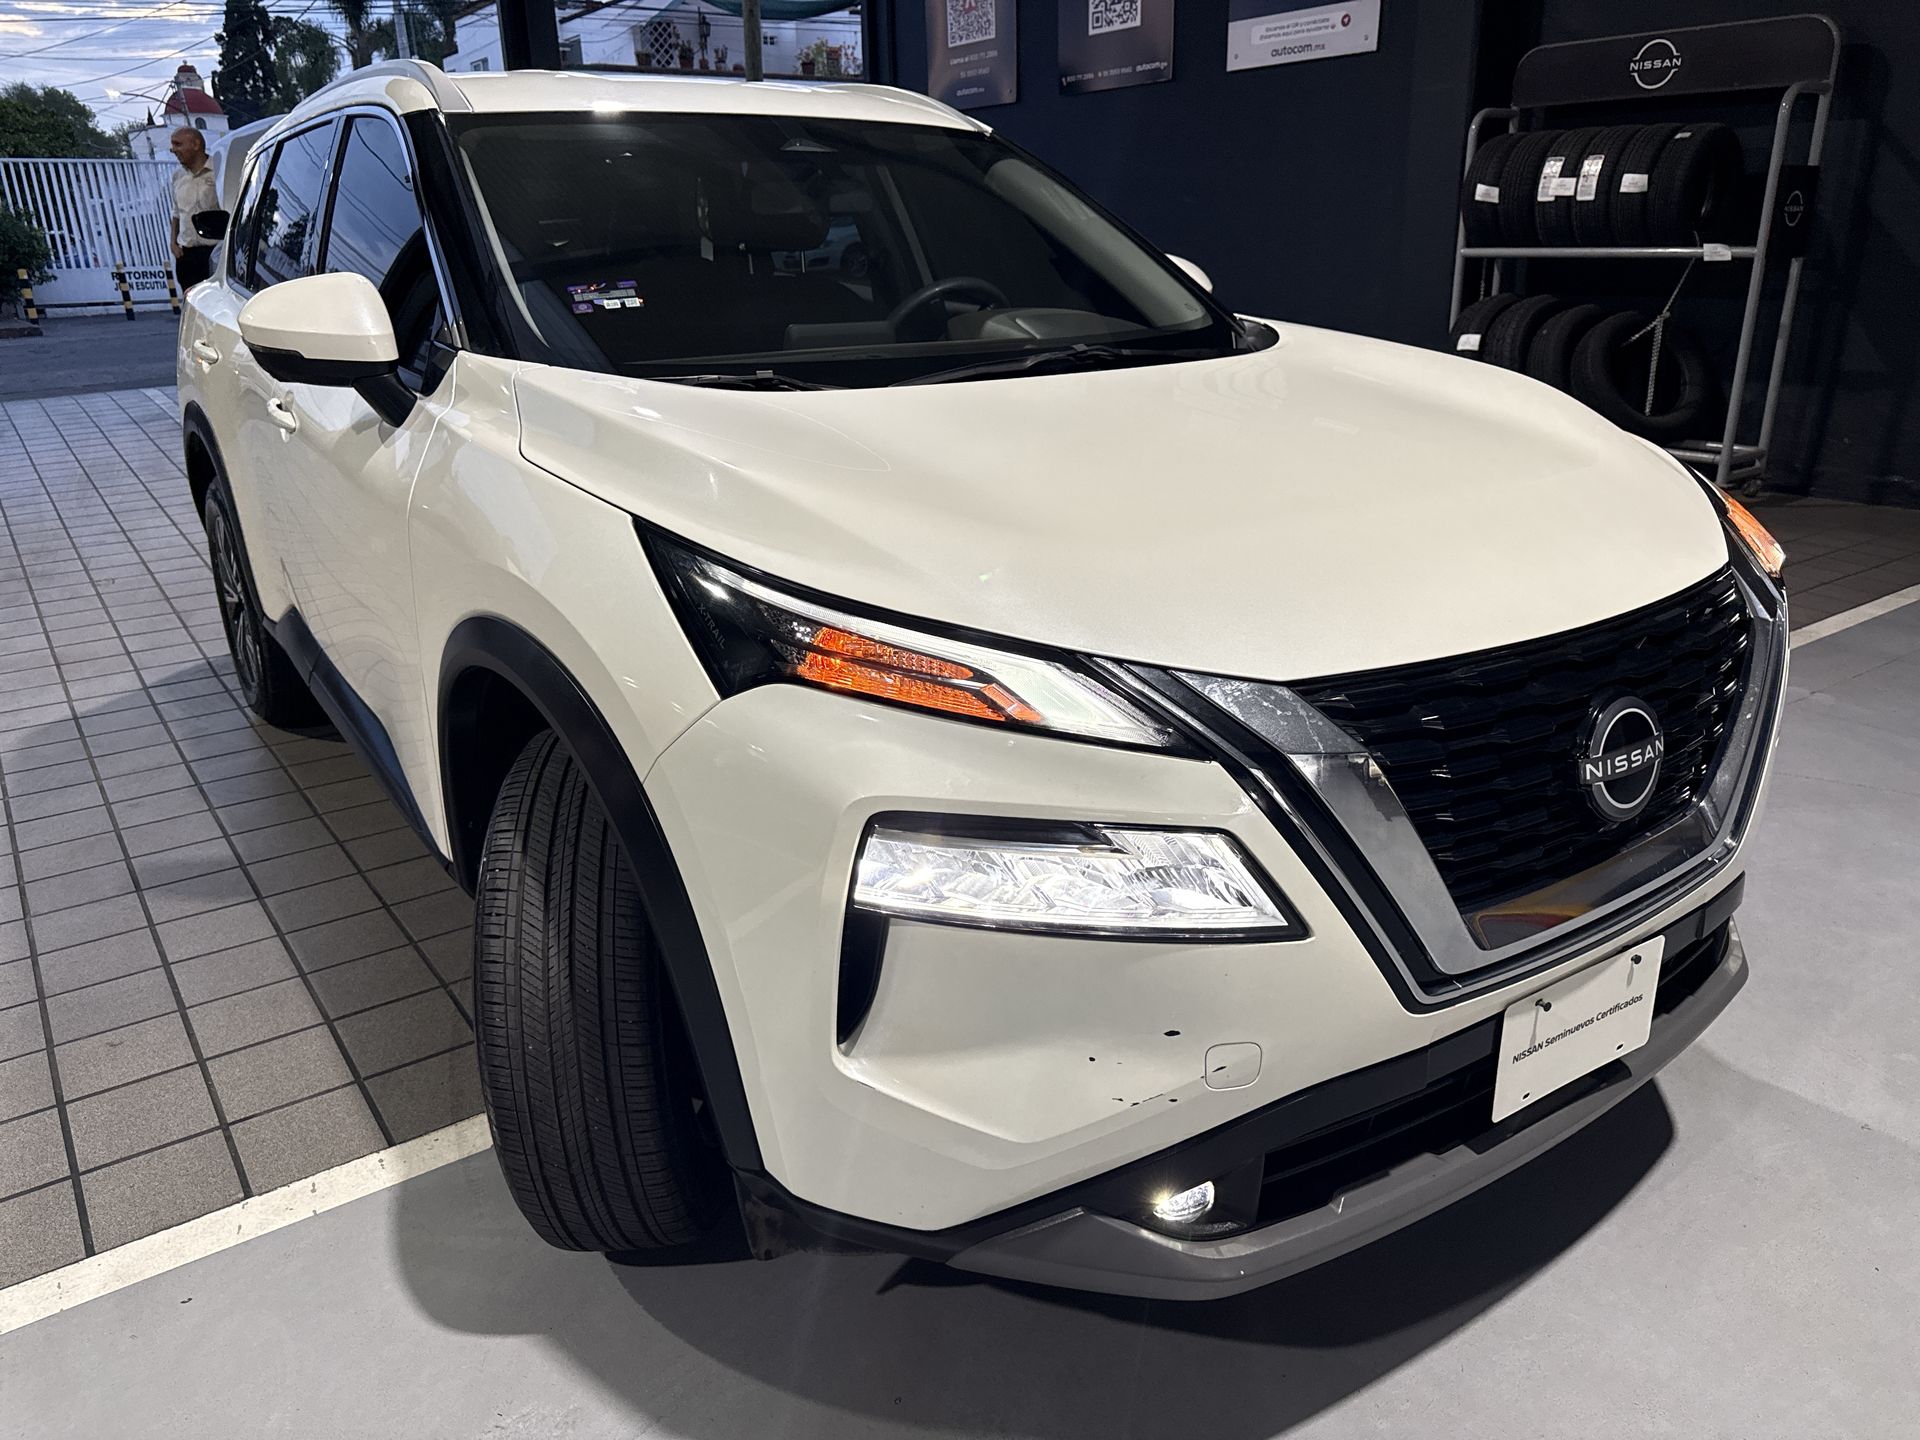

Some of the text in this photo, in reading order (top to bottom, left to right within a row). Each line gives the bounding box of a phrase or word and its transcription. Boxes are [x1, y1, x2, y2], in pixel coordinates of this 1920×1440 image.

[1630, 57, 1681, 71] NISSAN
[111, 270, 165, 280] RTORNO
[114, 281, 168, 291] JN ESCUTIA
[698, 603, 725, 649] X-TRAIL
[1585, 736, 1664, 780] NISSAN
[1512, 993, 1643, 1064] NISSAN Seminuevos Certificados
